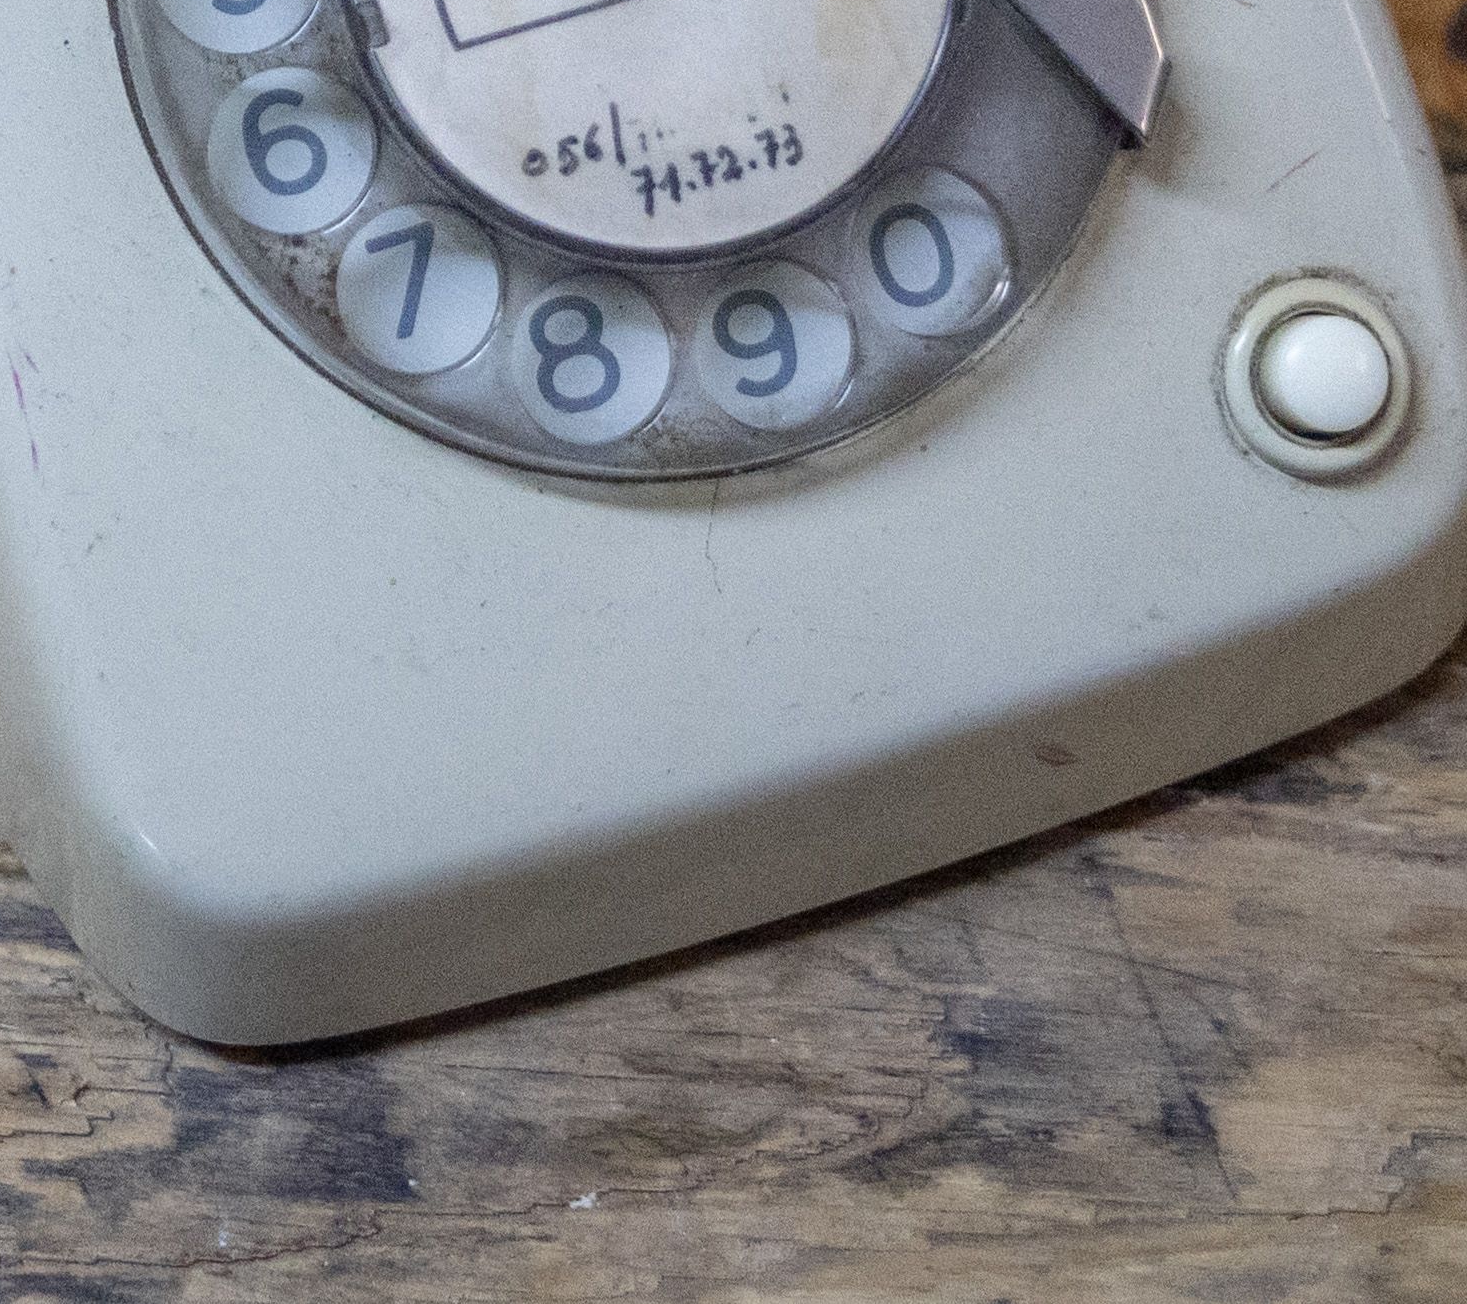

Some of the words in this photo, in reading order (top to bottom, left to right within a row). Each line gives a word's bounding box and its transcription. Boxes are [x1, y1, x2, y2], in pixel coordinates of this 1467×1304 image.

[241, 88, 327, 196] 6
[365, 219, 436, 339] 7
[870, 204, 954, 307] 0
[535, 295, 622, 413] 8
[712, 290, 797, 396] 9
